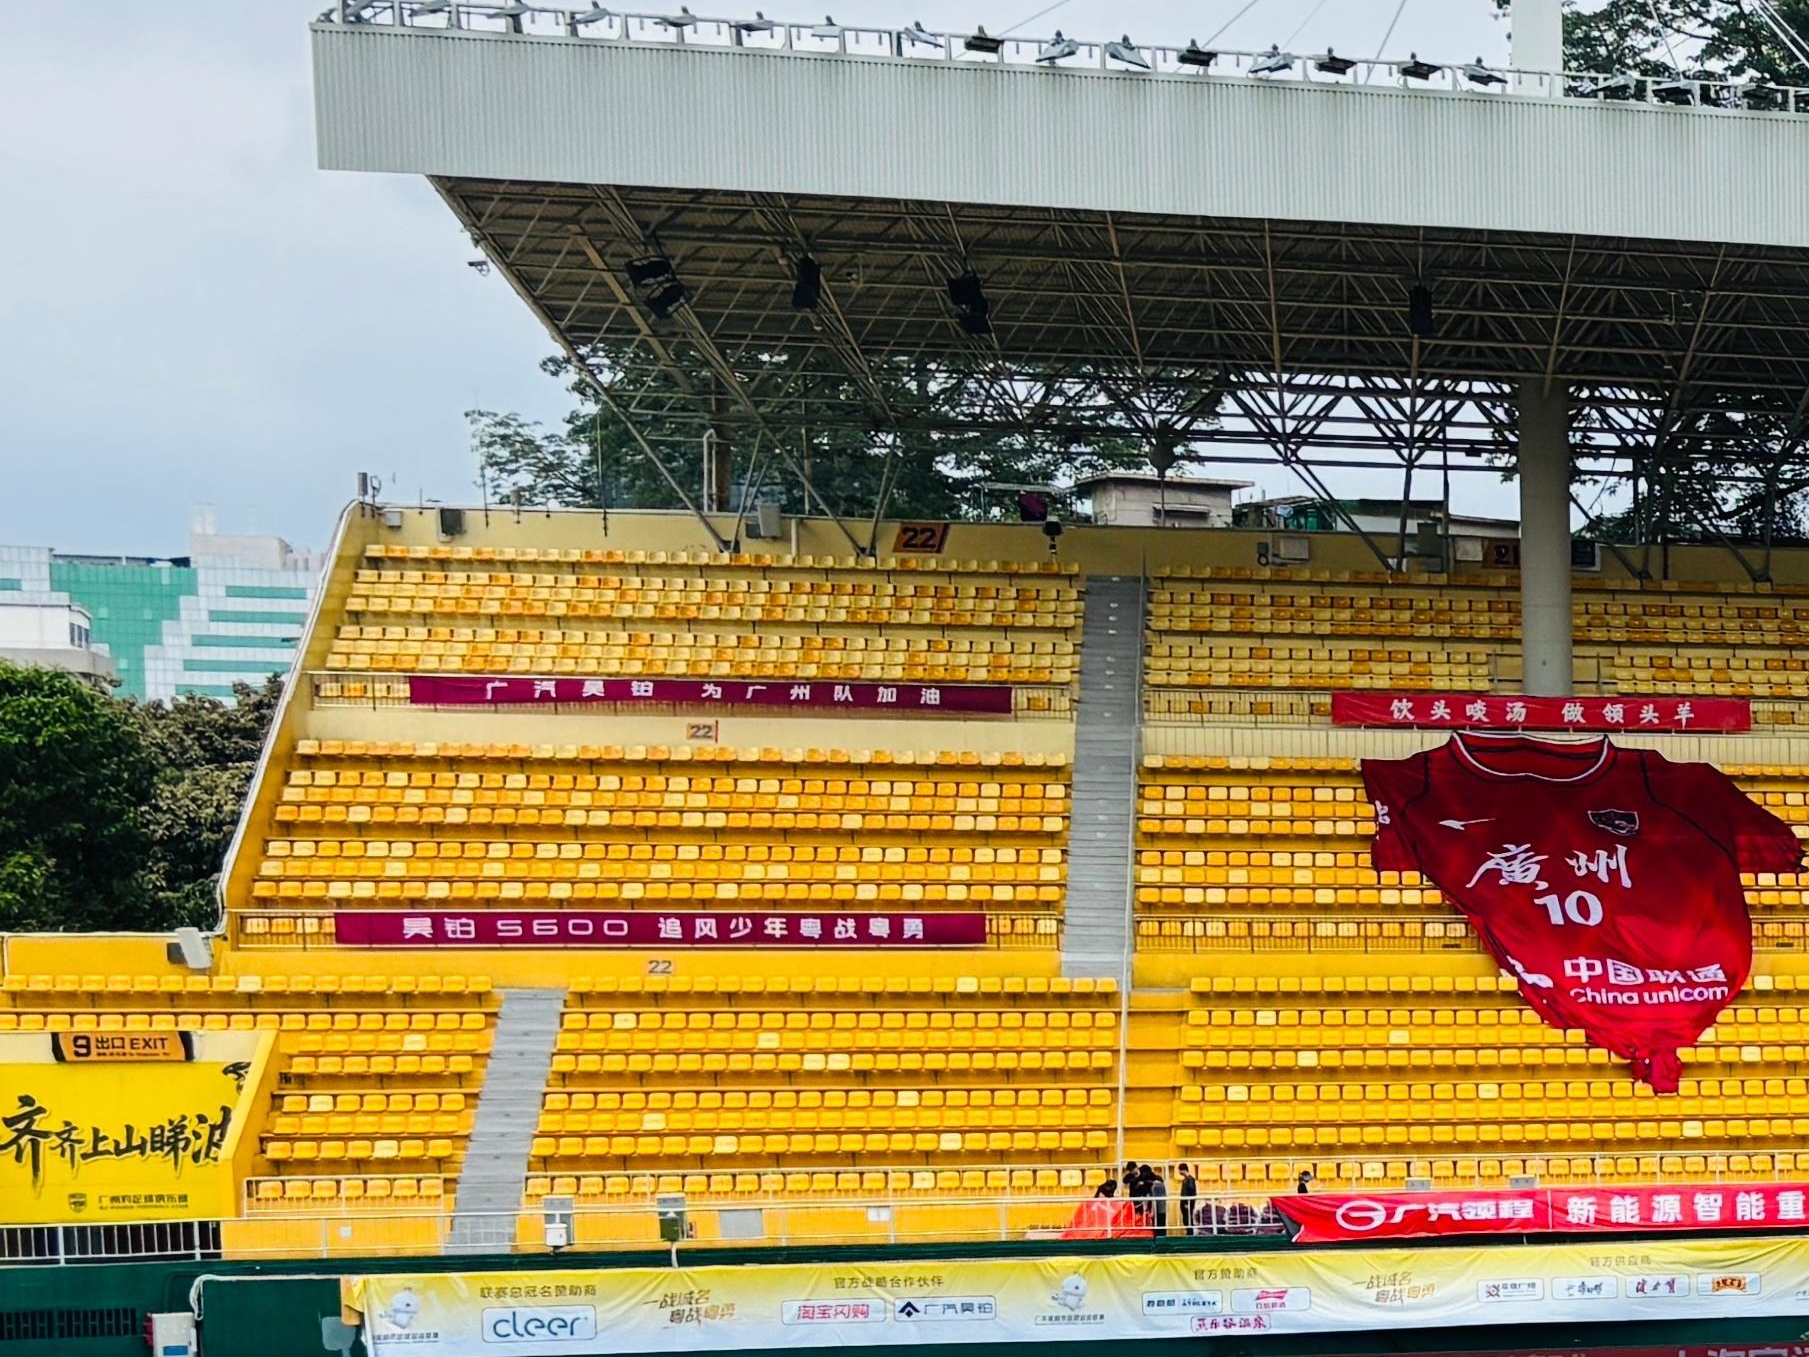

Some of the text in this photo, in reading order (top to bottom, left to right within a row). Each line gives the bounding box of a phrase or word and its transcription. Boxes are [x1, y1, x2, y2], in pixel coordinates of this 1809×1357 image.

[902, 527, 937, 549] 22
[702, 683, 942, 707] 为广州队加油
[1561, 701, 1696, 724] 做领头羊
[691, 725, 713, 740] 22
[1533, 890, 1604, 927] 10
[658, 916, 925, 941] 追风少年粤战粤勇
[649, 960, 673, 974] 22
[1569, 985, 1729, 1005] China unicom
[73, 1035, 169, 1058] 9 出口 EXIT
[797, 1303, 870, 1321] 淘宝闪购
[492, 1310, 584, 1338] cleer
